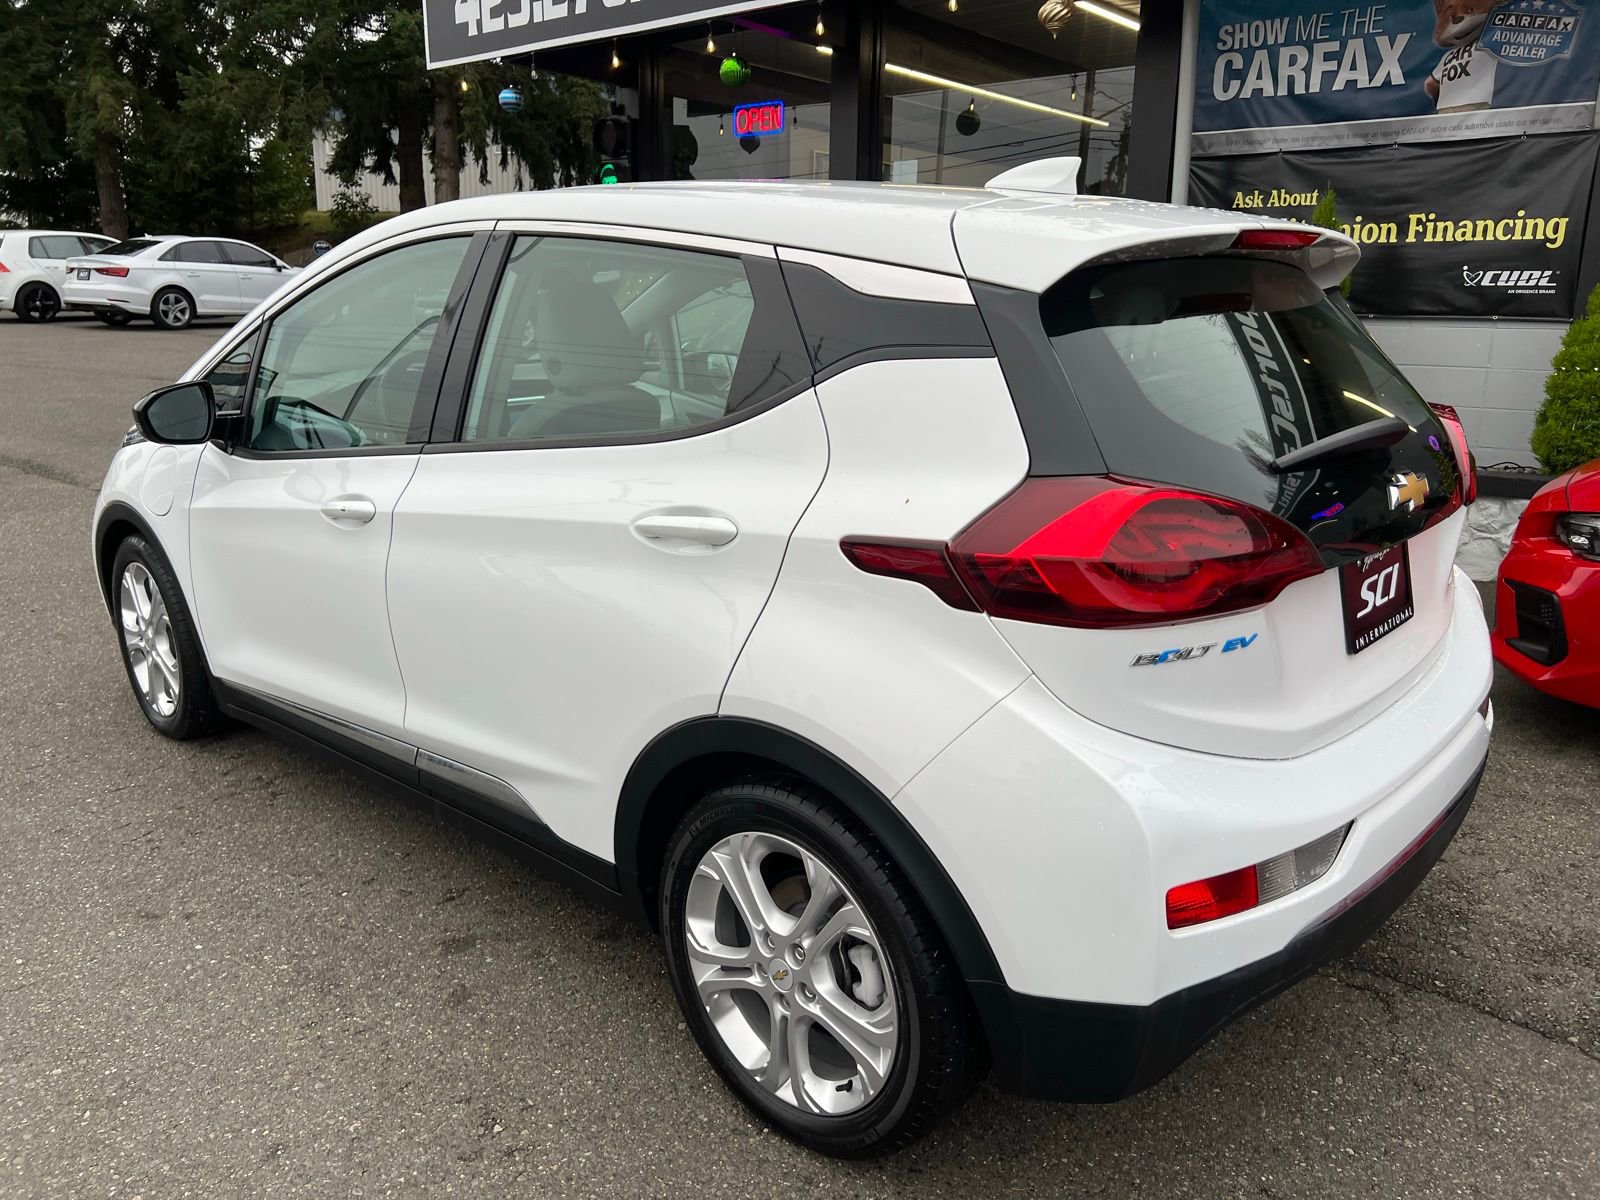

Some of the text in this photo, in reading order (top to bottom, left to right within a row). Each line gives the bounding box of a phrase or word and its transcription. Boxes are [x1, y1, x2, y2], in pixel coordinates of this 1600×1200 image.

[1216, 4, 1386, 51] SHOW ME THE
[1494, 14, 1572, 32] CARFAX
[1492, 31, 1563, 47] ADVANTAGE
[1501, 45, 1547, 59] DEALER
[1213, 32, 1412, 101] CARFAX
[1444, 43, 1473, 67] CAR
[1441, 60, 1471, 85] FOX
[736, 105, 783, 134] OPEN
[1232, 189, 1319, 208] Ask About
[1405, 209, 1569, 249] Financing
[1356, 562, 1400, 619] SCI
[1355, 606, 1413, 650] INTERNATIONAL
[1129, 633, 1258, 667] BOLT EV
